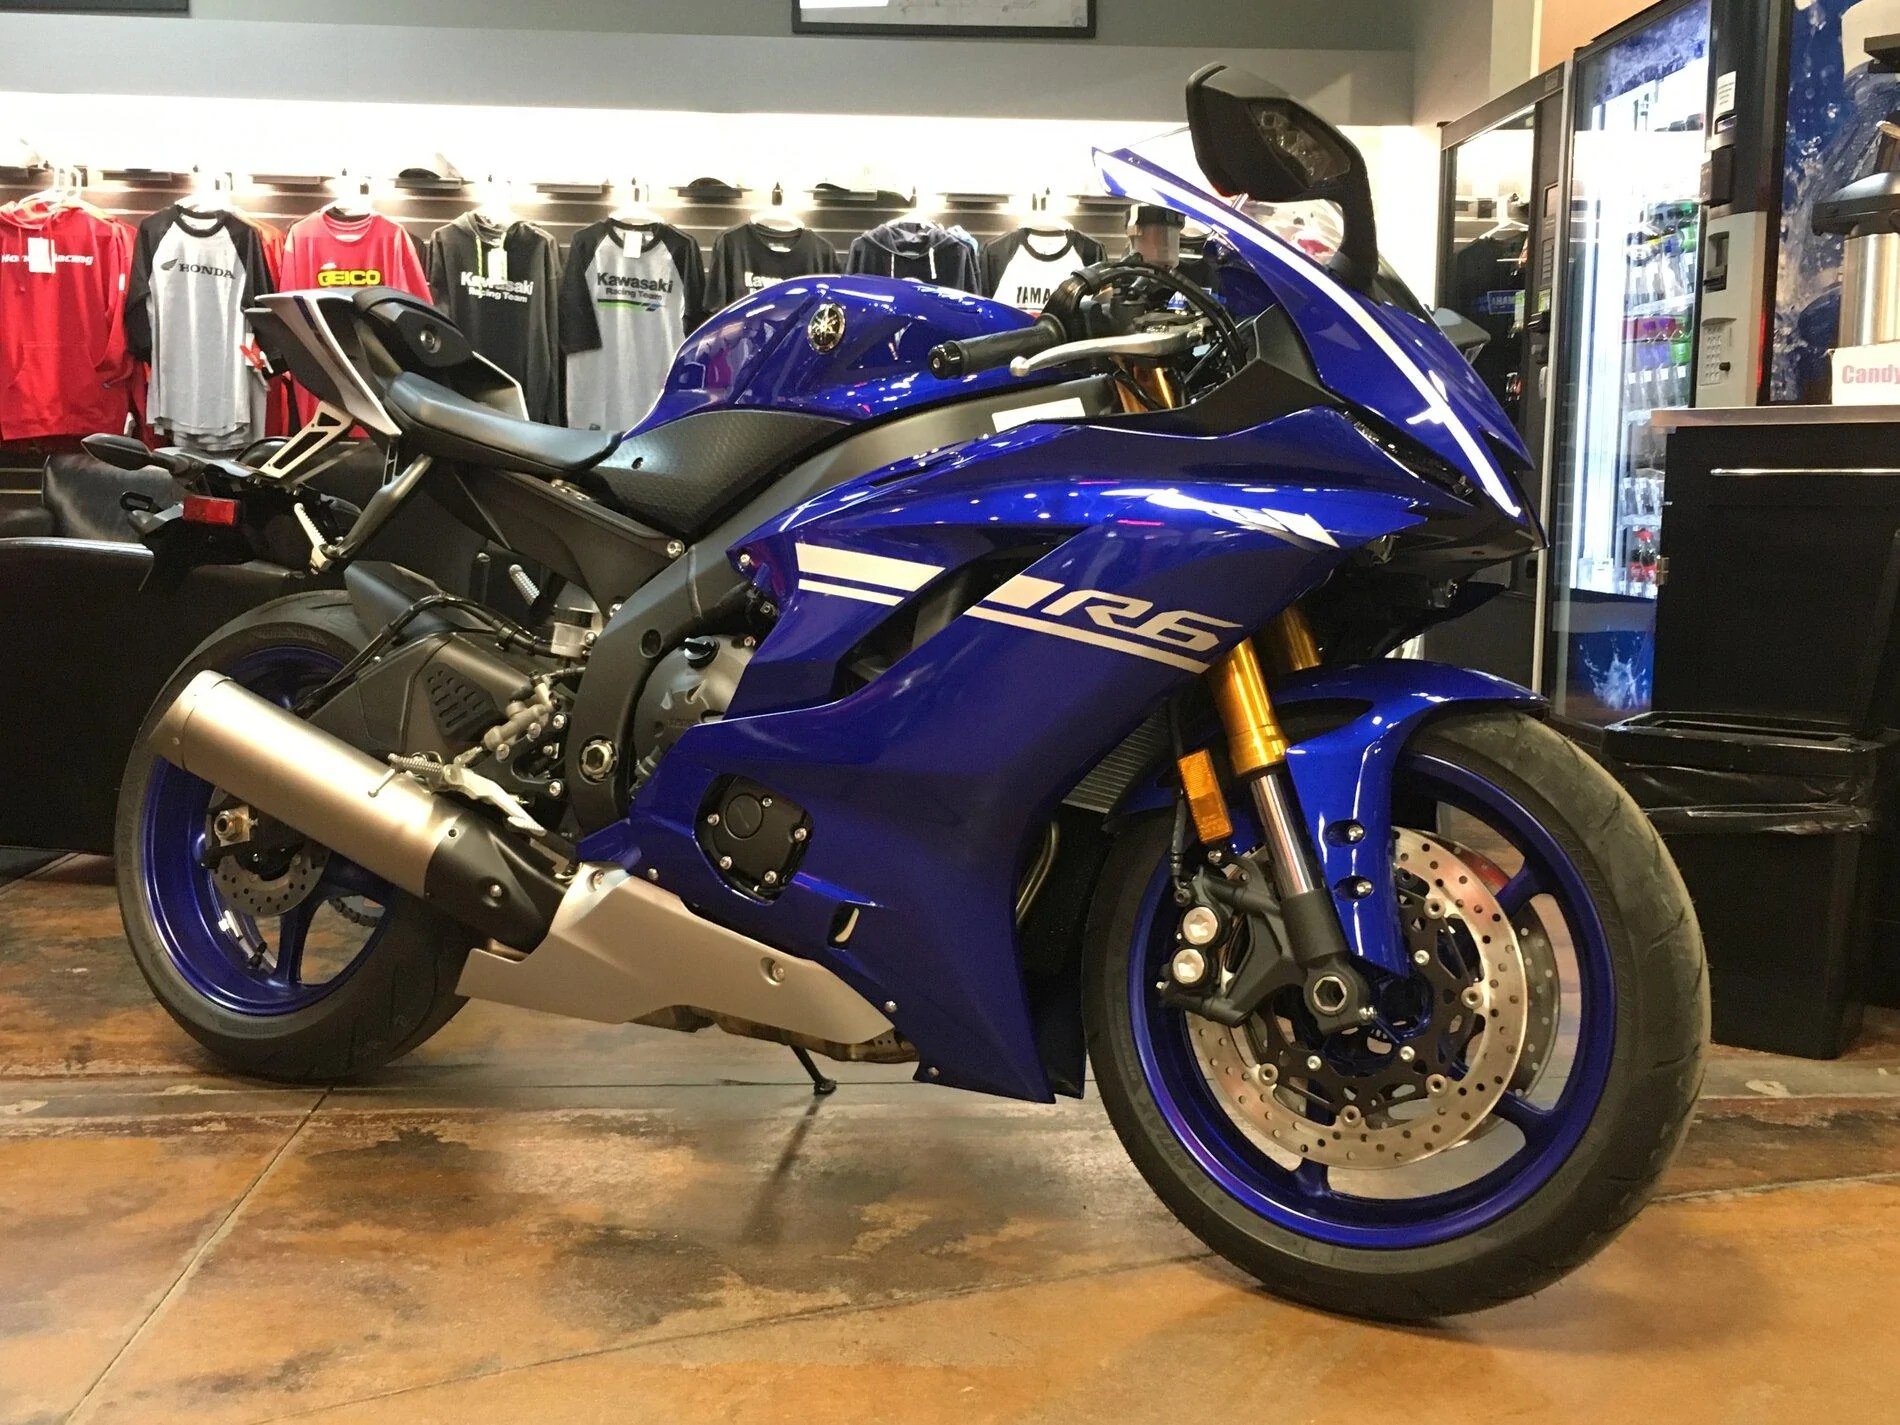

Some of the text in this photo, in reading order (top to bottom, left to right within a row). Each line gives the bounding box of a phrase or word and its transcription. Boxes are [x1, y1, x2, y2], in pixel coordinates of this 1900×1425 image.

[179, 263, 236, 279] HONDA
[317, 269, 381, 287] GEICO
[597, 272, 674, 293] Kawasaki
[503, 291, 528, 303] Team
[605, 287, 662, 300] Racing Team
[1016, 286, 1051, 304] YAMA
[1040, 589, 1244, 652] R6
